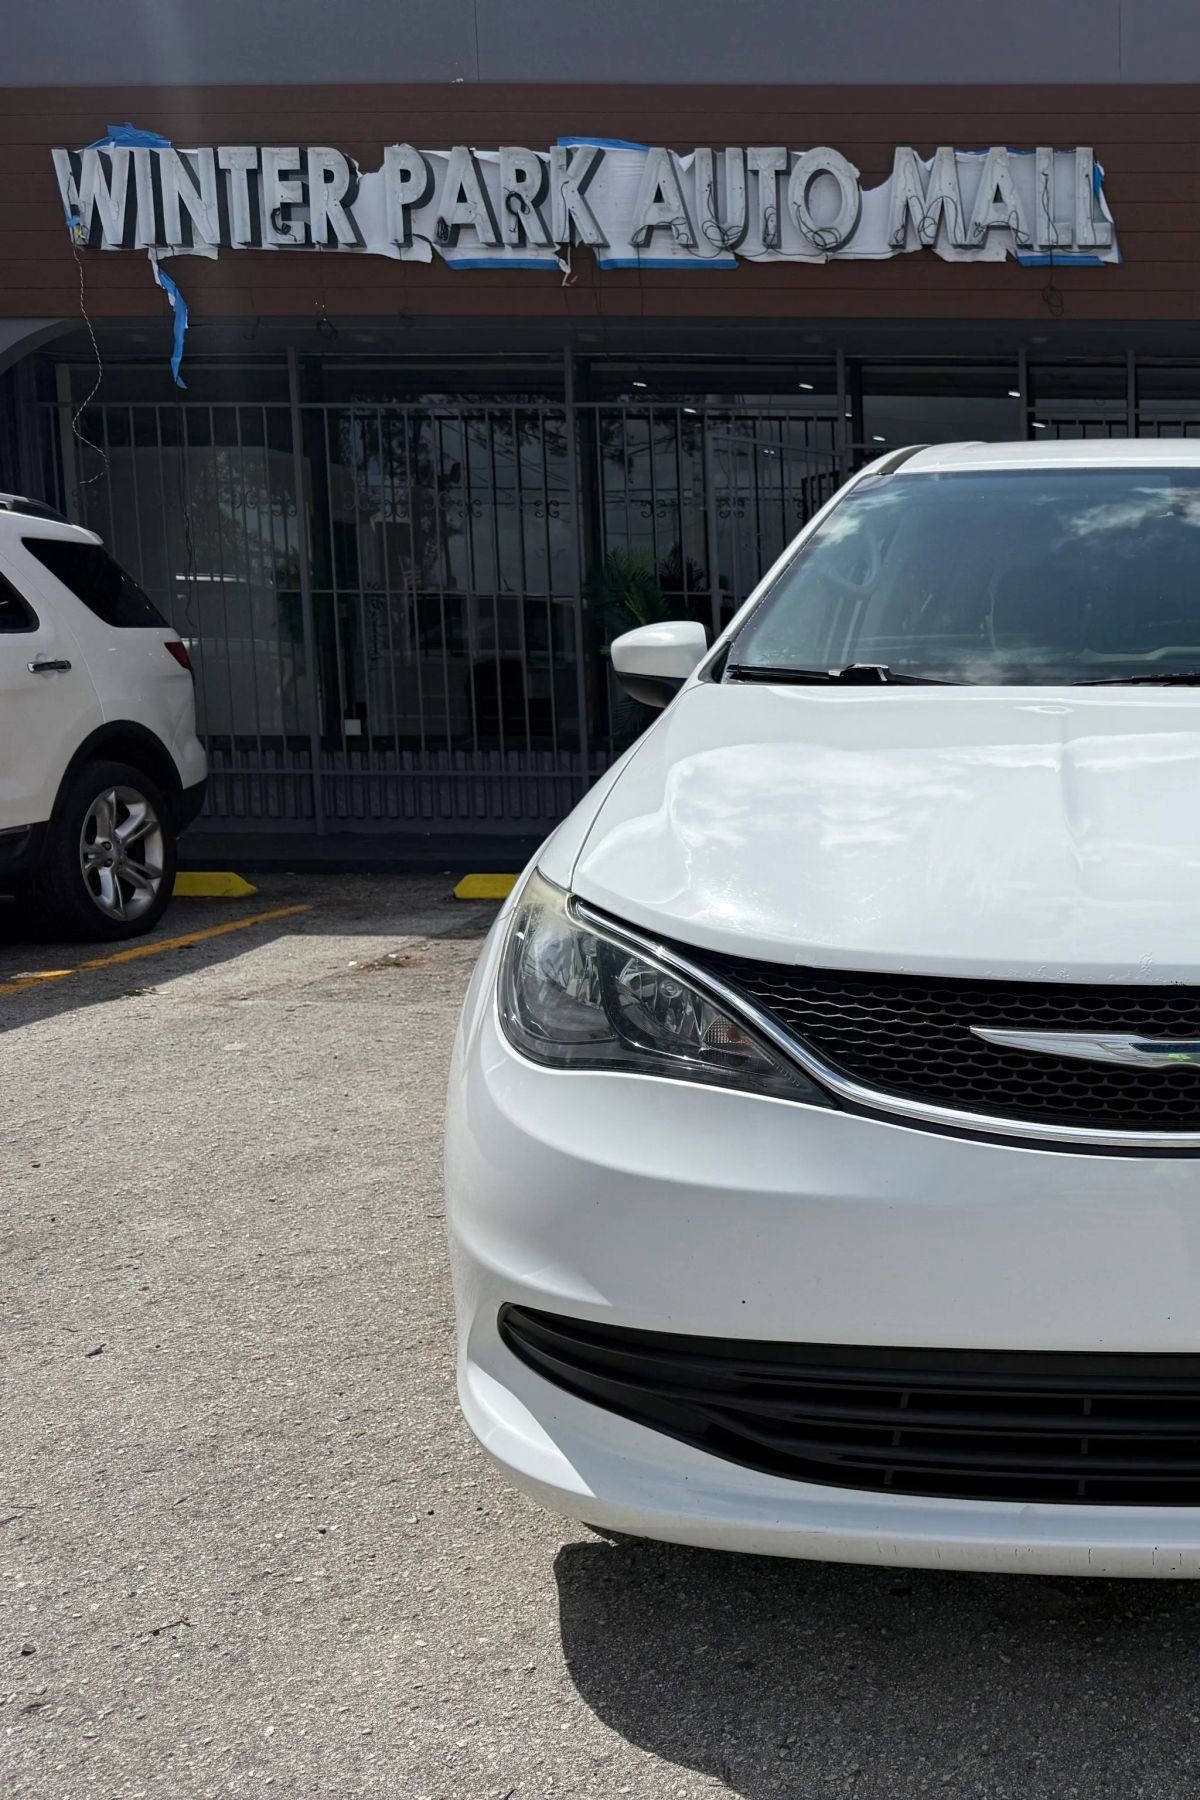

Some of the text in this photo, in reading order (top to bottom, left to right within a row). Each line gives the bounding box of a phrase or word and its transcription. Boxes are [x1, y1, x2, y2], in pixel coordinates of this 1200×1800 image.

[51, 145, 1112, 249] WINTER PARK AUTO MALL
